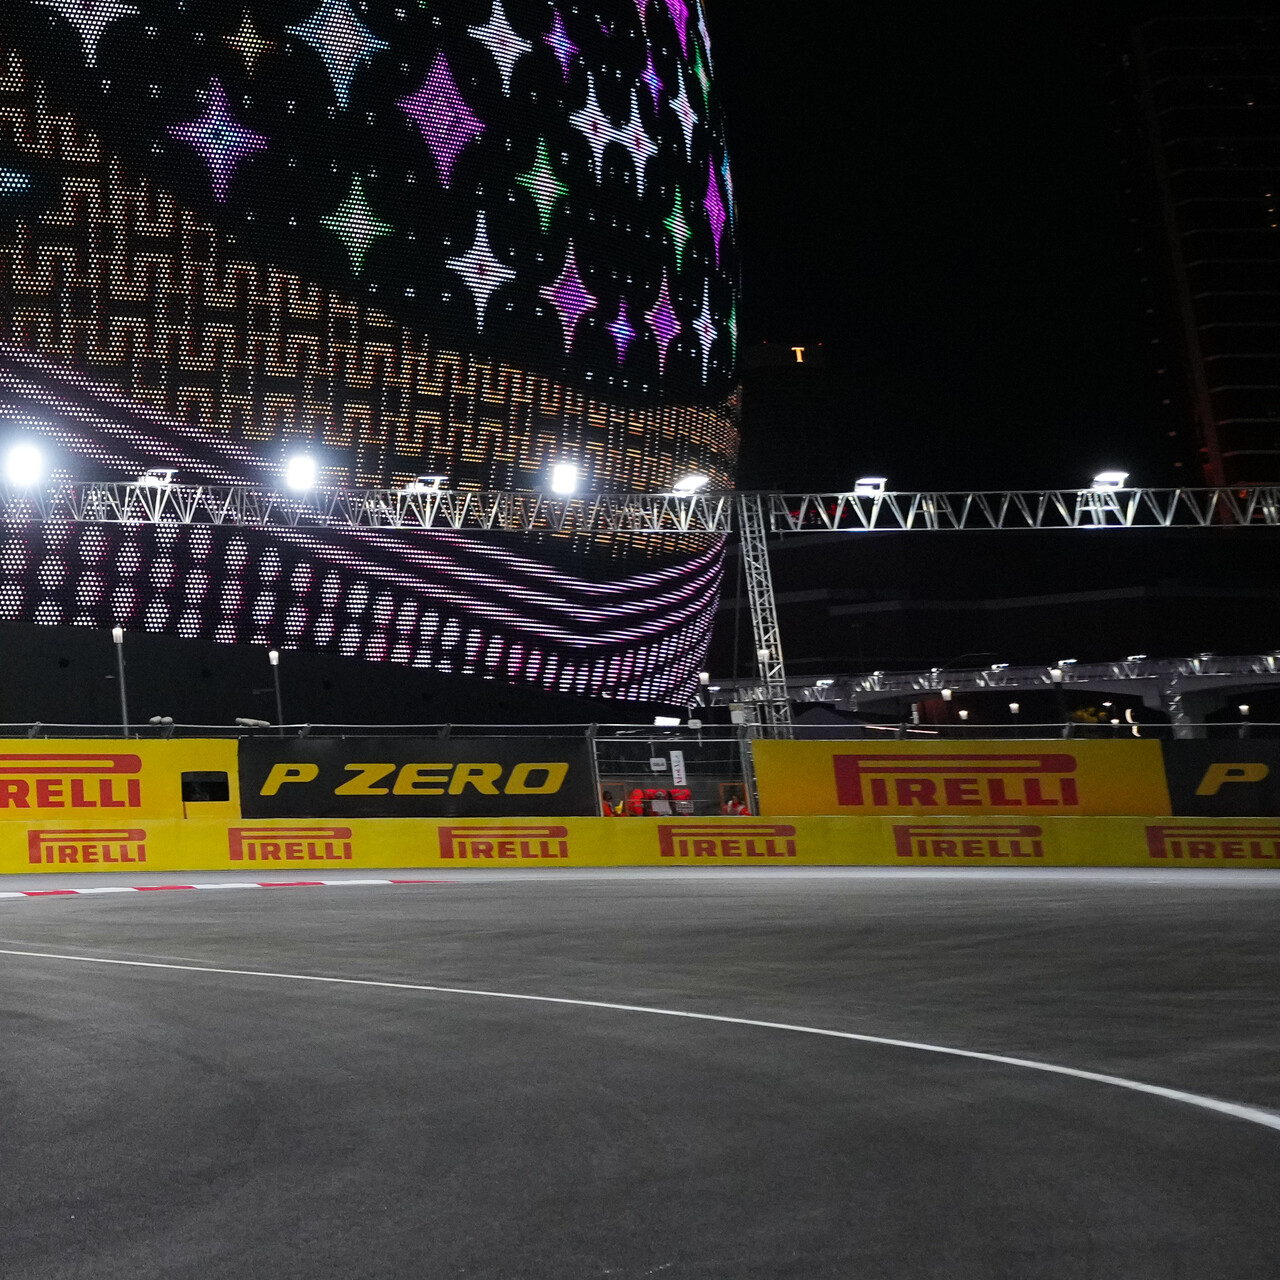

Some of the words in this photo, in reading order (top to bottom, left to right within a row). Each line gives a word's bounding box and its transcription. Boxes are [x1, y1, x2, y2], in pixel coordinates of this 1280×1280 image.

[259, 763, 319, 796] P
[335, 762, 570, 796] ZERO
[833, 754, 1077, 807] PIRELLI
[1195, 763, 1269, 795] P
[28, 828, 147, 864] PIRELLI
[228, 827, 353, 862] PIRELLI
[440, 826, 569, 860] PIRELLI
[658, 824, 797, 858] PIRELLI
[894, 824, 1044, 859] PIRELLI
[1145, 825, 1280, 859] PIREL
